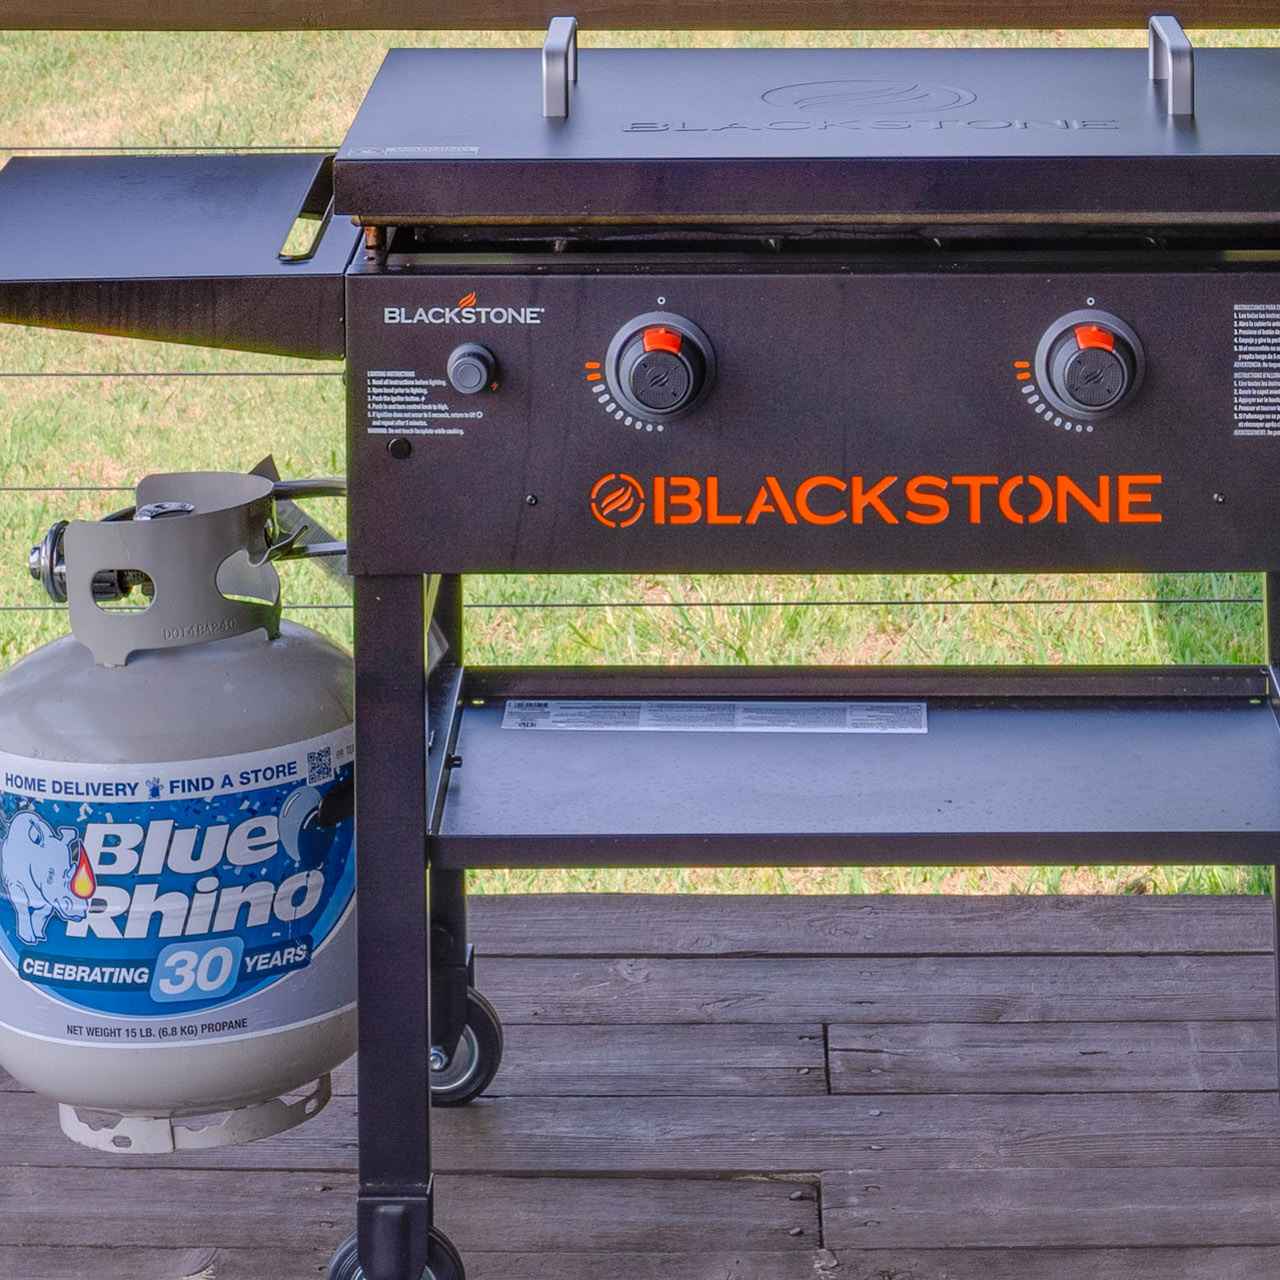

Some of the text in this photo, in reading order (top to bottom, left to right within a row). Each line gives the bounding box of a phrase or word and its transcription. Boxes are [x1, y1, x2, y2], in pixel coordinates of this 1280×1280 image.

[383, 306, 541, 325] BLACKSTONE
[653, 475, 1163, 526] BLACKSTONE
[5, 772, 140, 797] HOME DELIVERY
[169, 761, 298, 794] FIND A STORE
[80, 815, 280, 876] Blue
[65, 868, 326, 939] Rhino
[23, 943, 308, 995] CELEBRATING 30 YEARS
[66, 1018, 248, 1039] NET WEIGHT 15 LB. (6.8 KG) PROPANE
